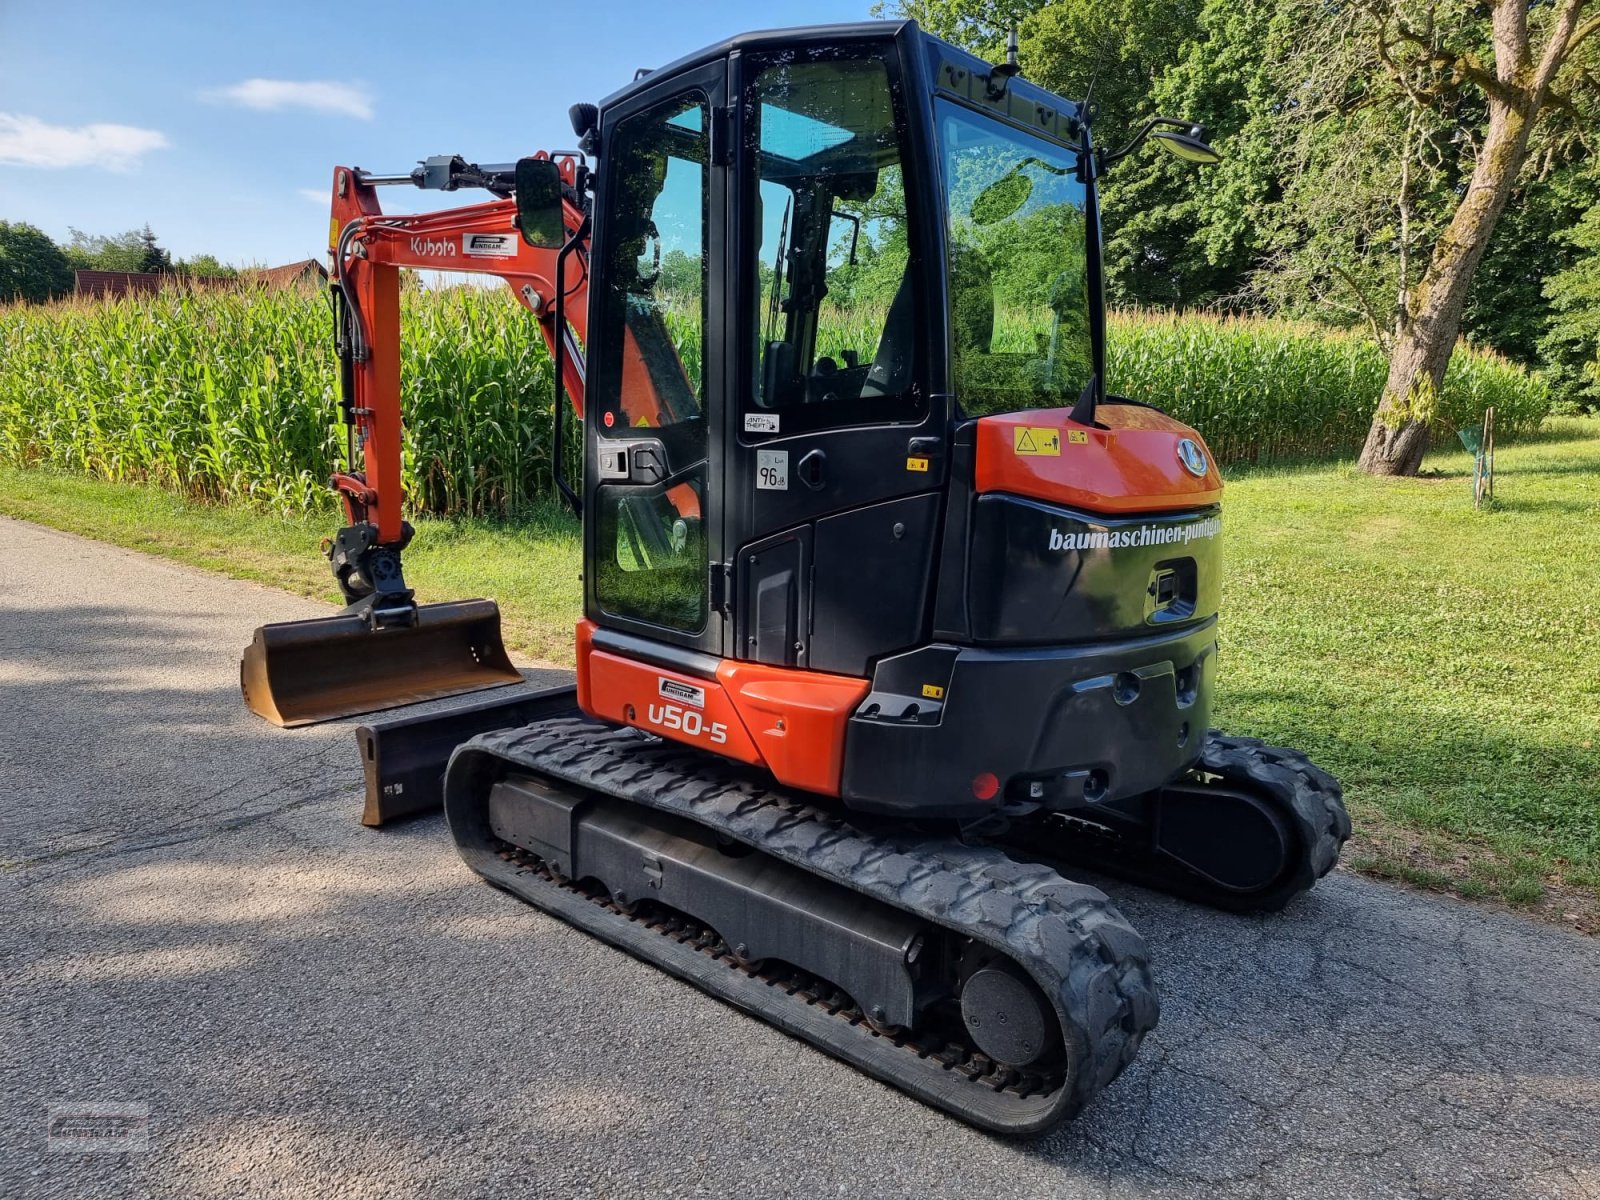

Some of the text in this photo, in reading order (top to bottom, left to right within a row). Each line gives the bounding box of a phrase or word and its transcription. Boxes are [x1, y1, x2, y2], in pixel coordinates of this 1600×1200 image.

[410, 236, 456, 257] Kubota
[760, 467, 786, 486] 96 dB
[648, 703, 728, 744] U50-5
